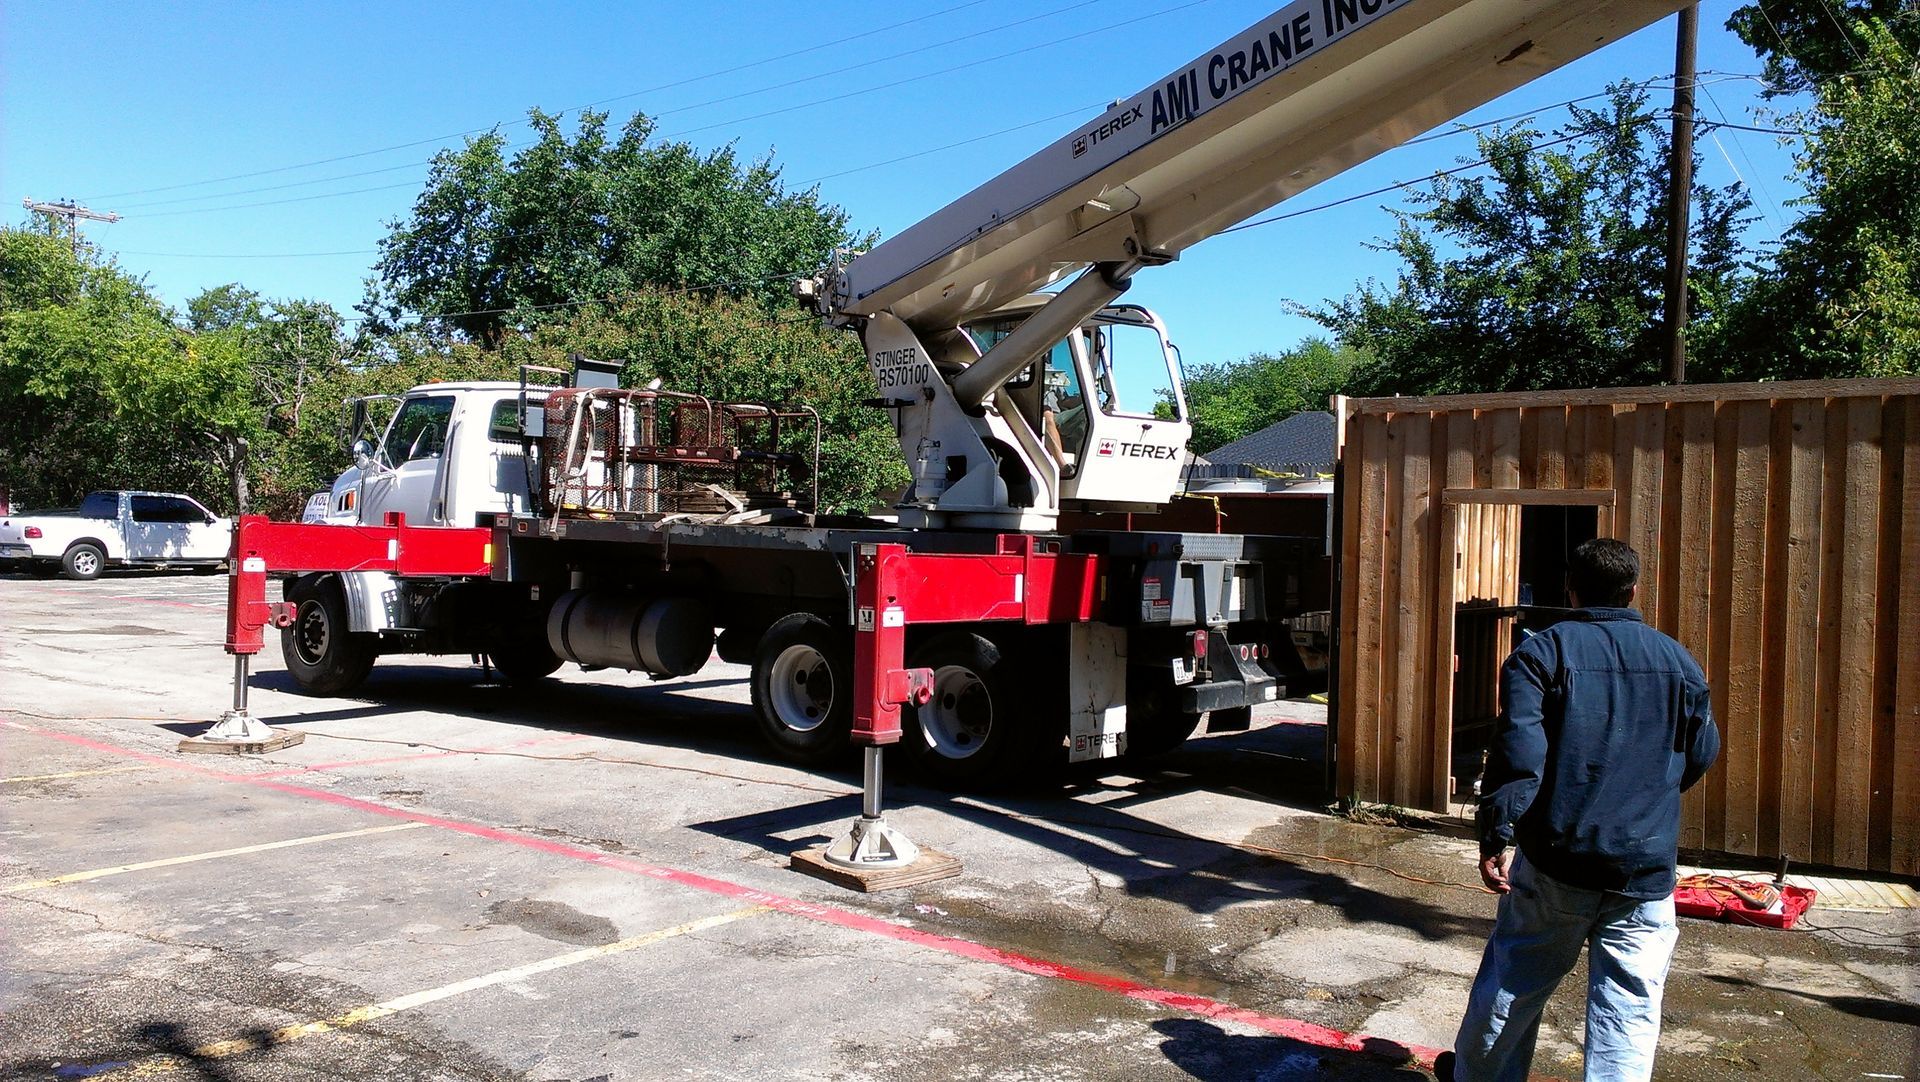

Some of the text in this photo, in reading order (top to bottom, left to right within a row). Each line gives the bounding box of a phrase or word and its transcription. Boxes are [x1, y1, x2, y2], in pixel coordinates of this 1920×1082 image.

[1151, 68, 1199, 135] AMI
[1089, 103, 1144, 145] TEREX
[875, 348, 915, 368] STINGER
[880, 364, 929, 388] RS70100
[1120, 442, 1179, 461] TEREX
